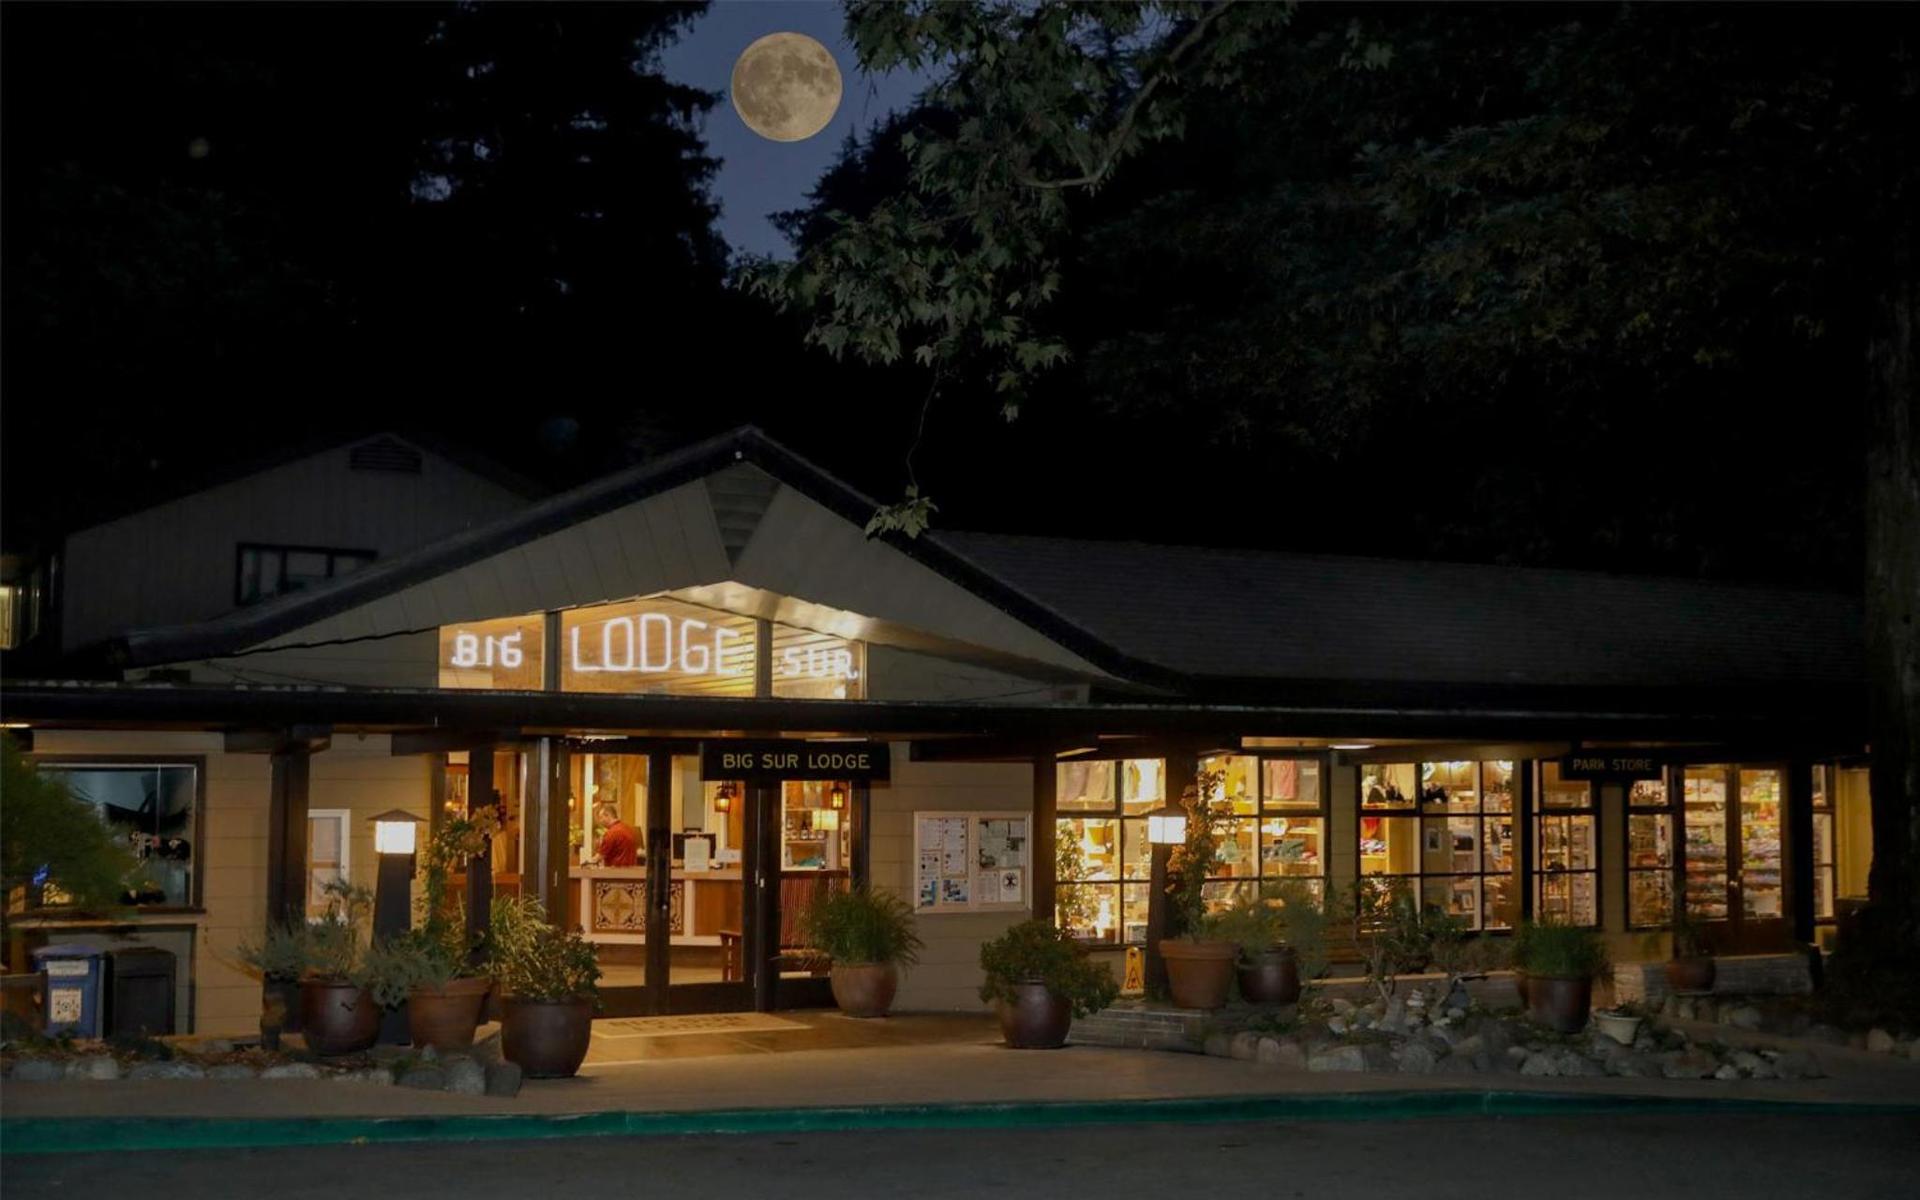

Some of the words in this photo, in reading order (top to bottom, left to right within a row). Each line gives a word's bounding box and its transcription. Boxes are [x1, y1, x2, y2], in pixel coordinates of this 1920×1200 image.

[452, 631, 522, 668] BIG
[571, 613, 740, 675] LODGE
[780, 647, 858, 679] SUR
[722, 753, 753, 769] BIG
[762, 753, 799, 769] SUR
[808, 753, 871, 769] LODGE
[1572, 758, 1606, 771] PARK
[1611, 758, 1655, 771] STORE
